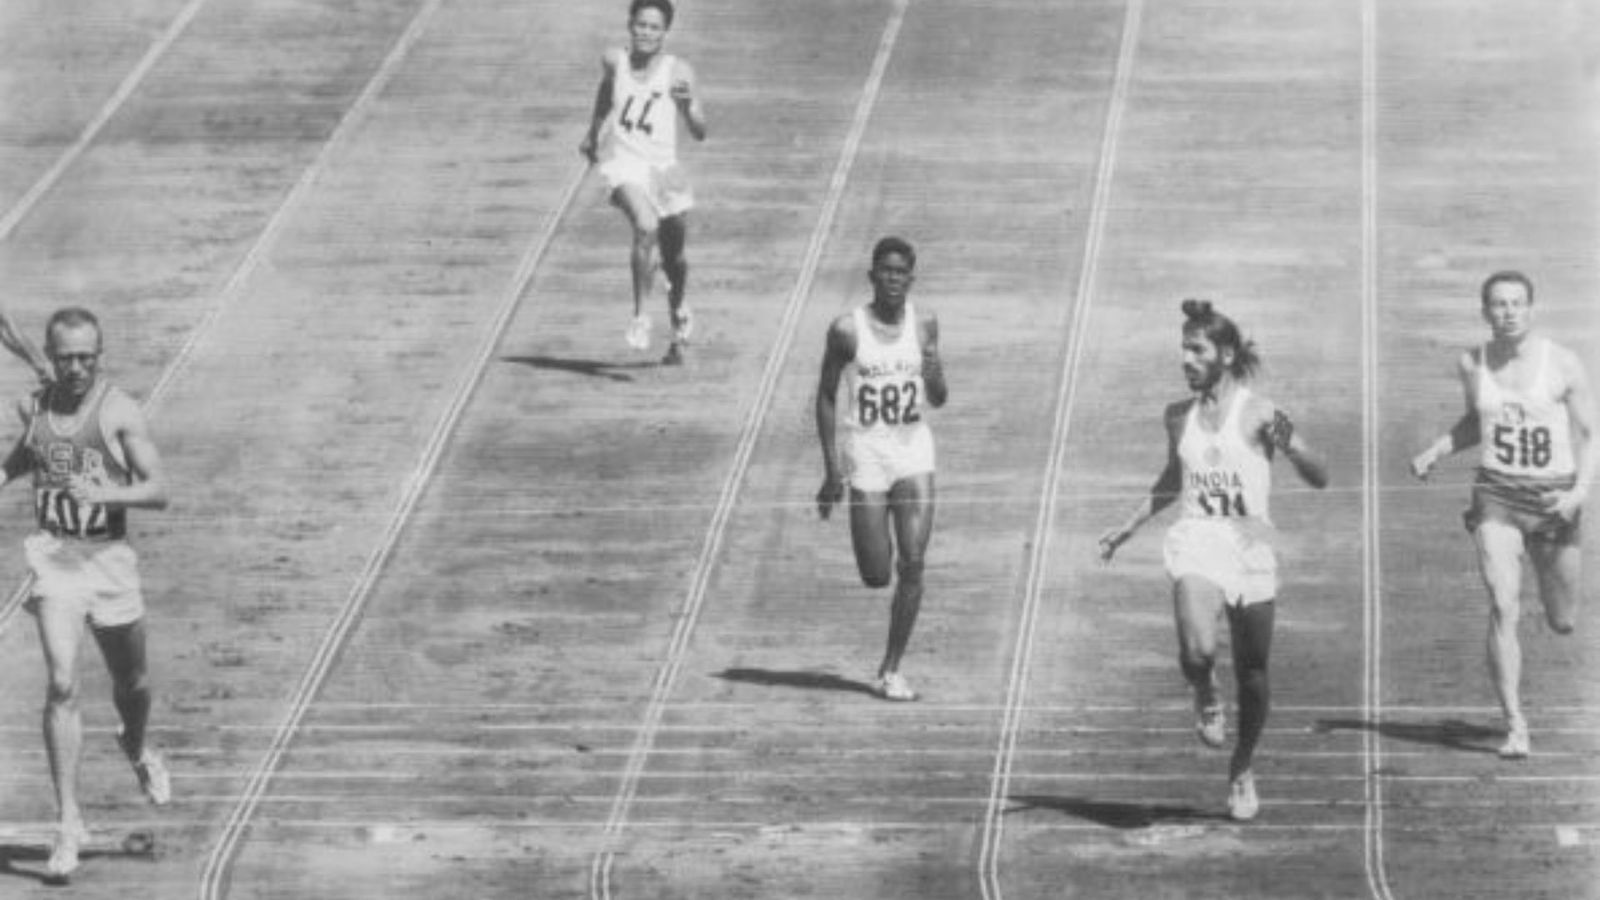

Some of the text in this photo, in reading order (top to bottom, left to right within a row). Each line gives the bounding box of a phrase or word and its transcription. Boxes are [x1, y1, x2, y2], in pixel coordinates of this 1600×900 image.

[859, 381, 921, 427] 682
[1494, 424, 1552, 468] 518
[1190, 470, 1242, 488] INDIA
